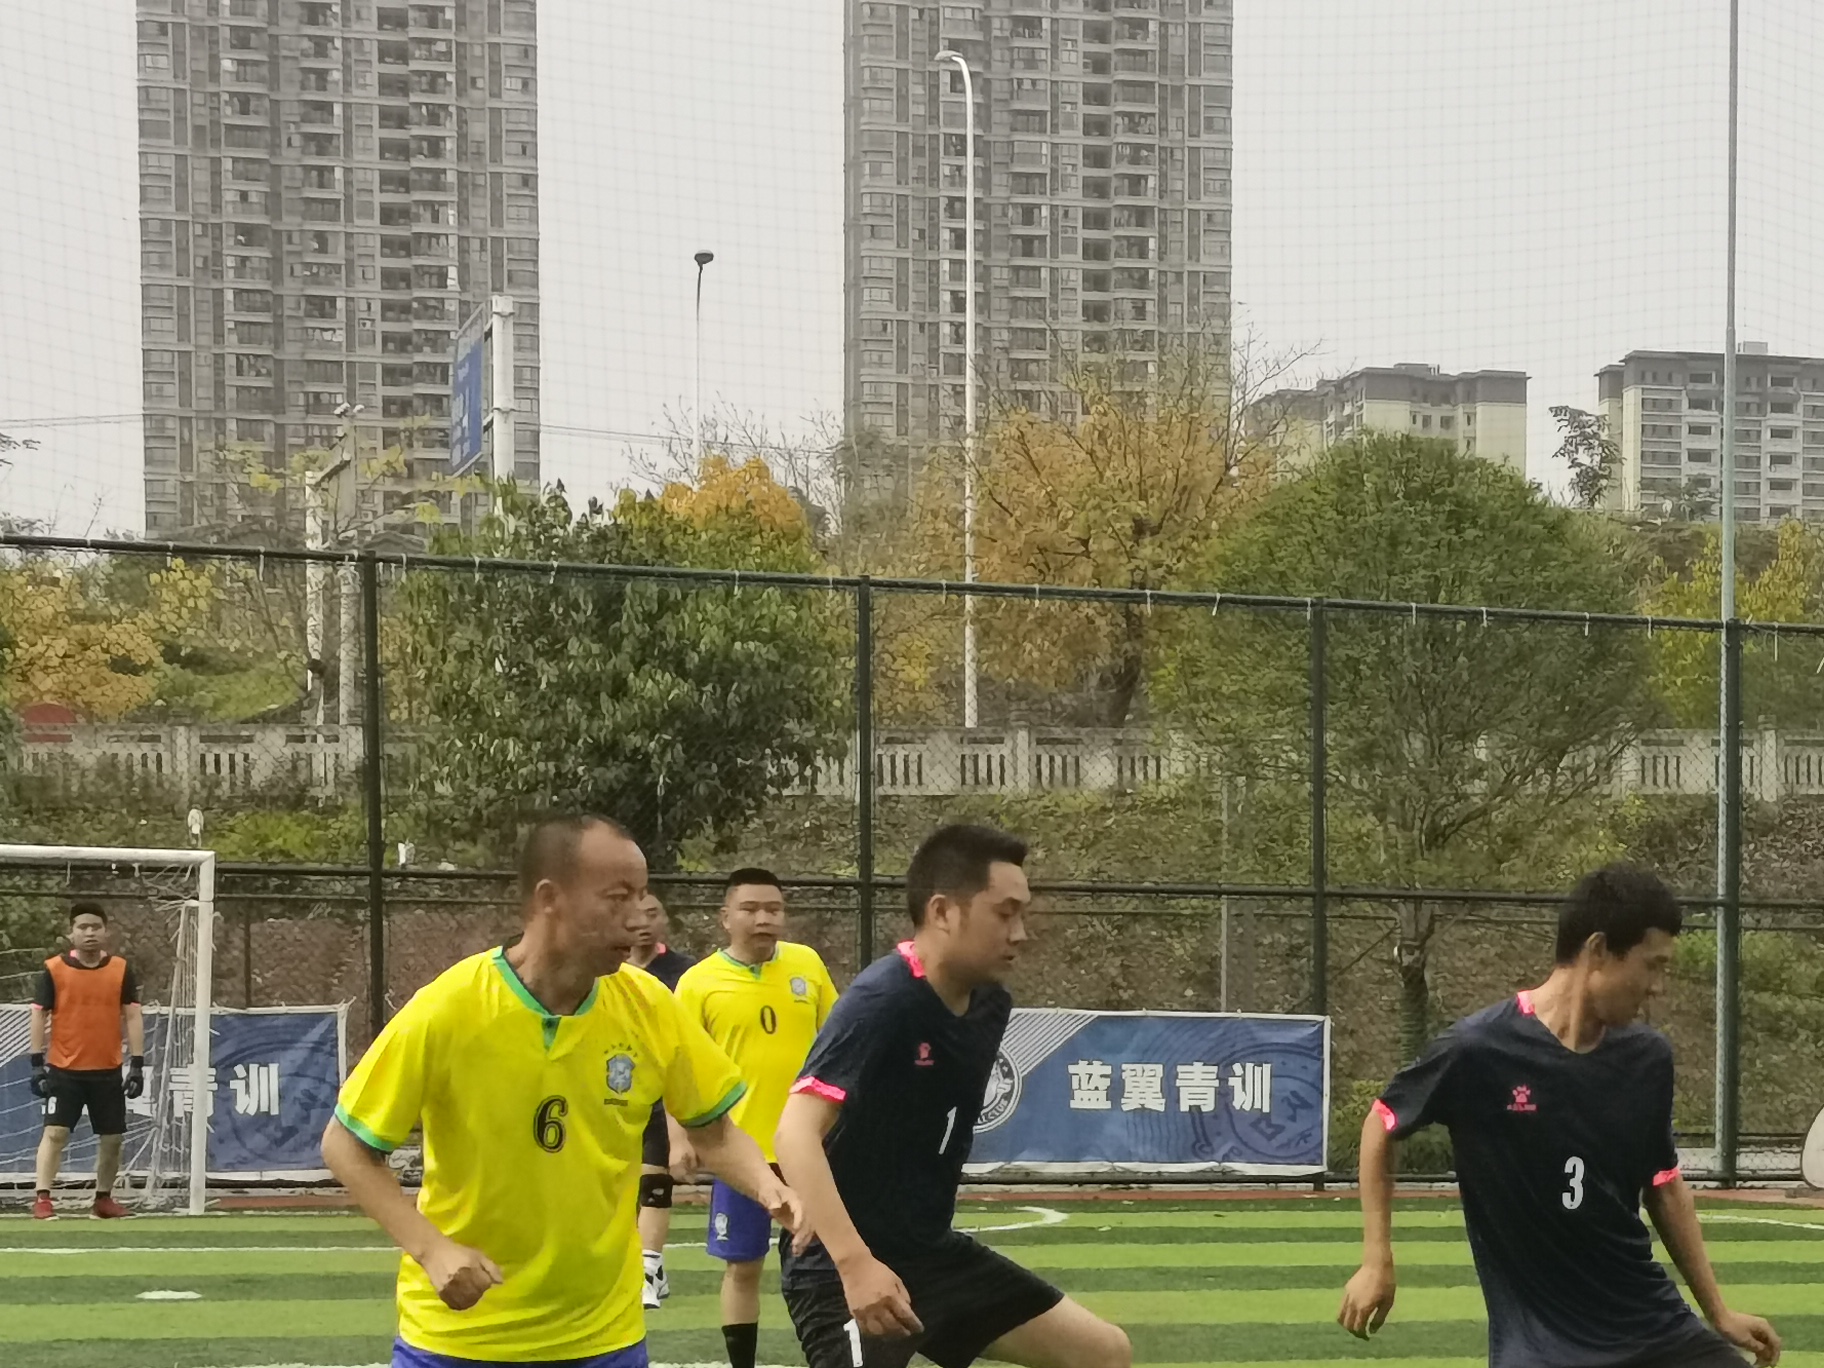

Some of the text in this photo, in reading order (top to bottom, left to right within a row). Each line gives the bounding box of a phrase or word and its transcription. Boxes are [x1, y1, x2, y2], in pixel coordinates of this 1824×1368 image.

[760, 1005, 777, 1035] 0
[1067, 1059, 1272, 1114] 蓝翼青训
[533, 1094, 568, 1153] 6
[938, 1106, 957, 1155] 1
[1562, 1156, 1585, 1210] 3
[843, 1318, 864, 1368] 1
